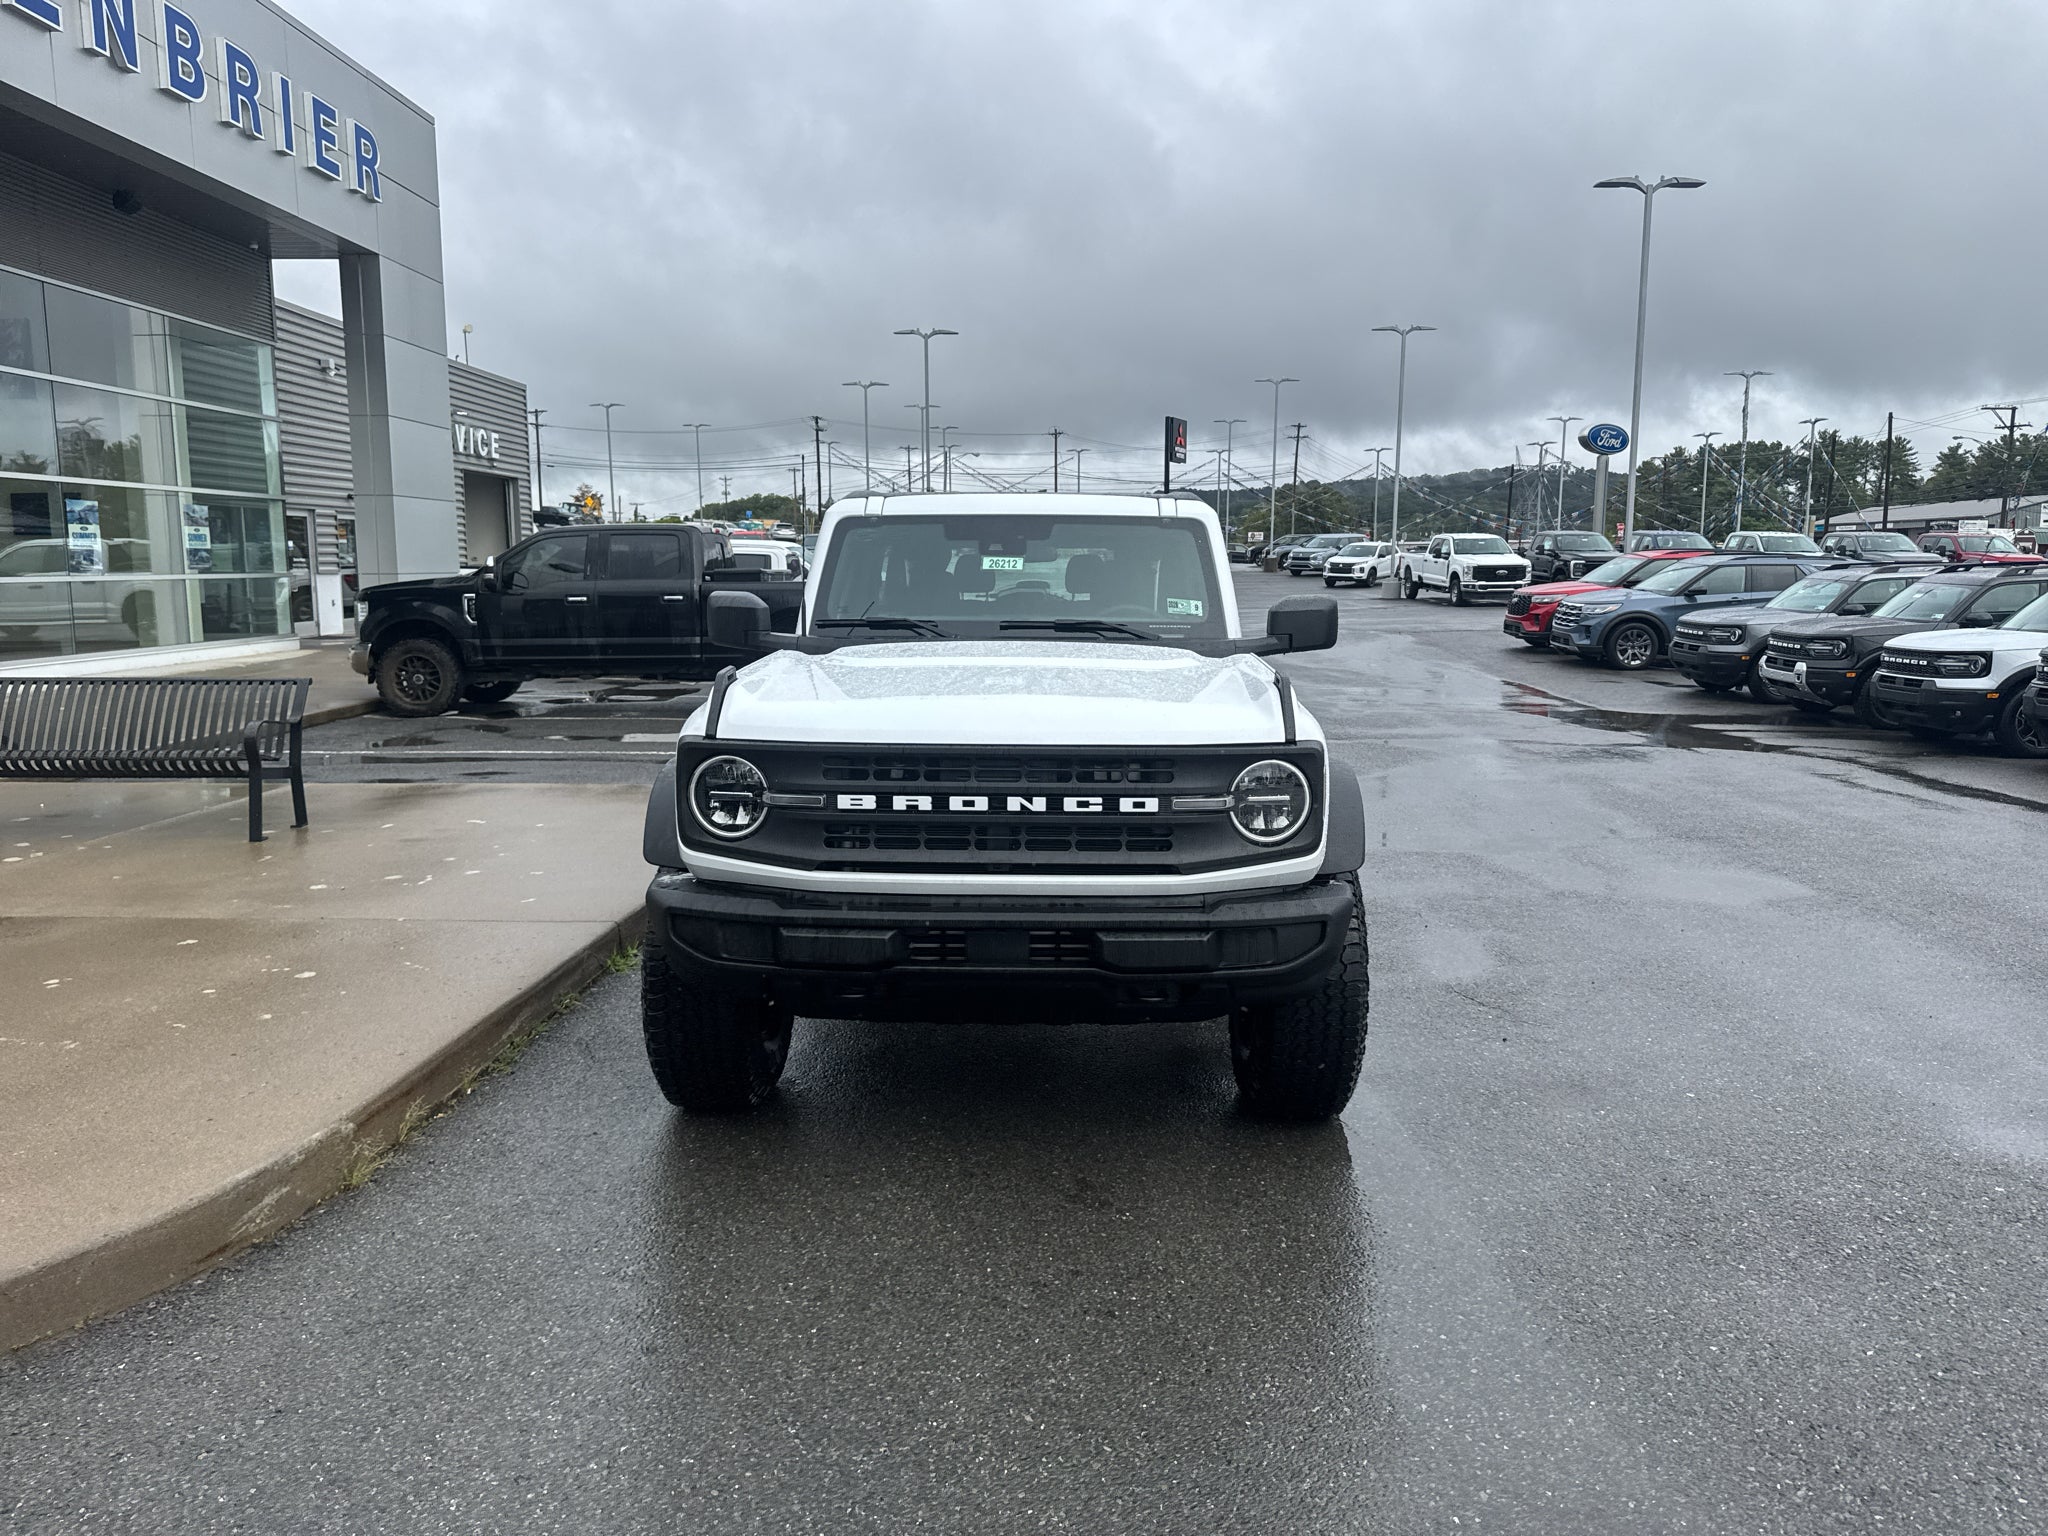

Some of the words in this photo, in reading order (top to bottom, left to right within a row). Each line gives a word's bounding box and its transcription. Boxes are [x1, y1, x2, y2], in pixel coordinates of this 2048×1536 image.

[2, 0, 382, 203] NBRIER
[1597, 428, 1623, 448] Ford
[988, 558, 1018, 569] 26212
[1769, 640, 1801, 649] BRONCO
[1884, 656, 1928, 665] BRONCO
[837, 794, 1159, 812] BRONCO
